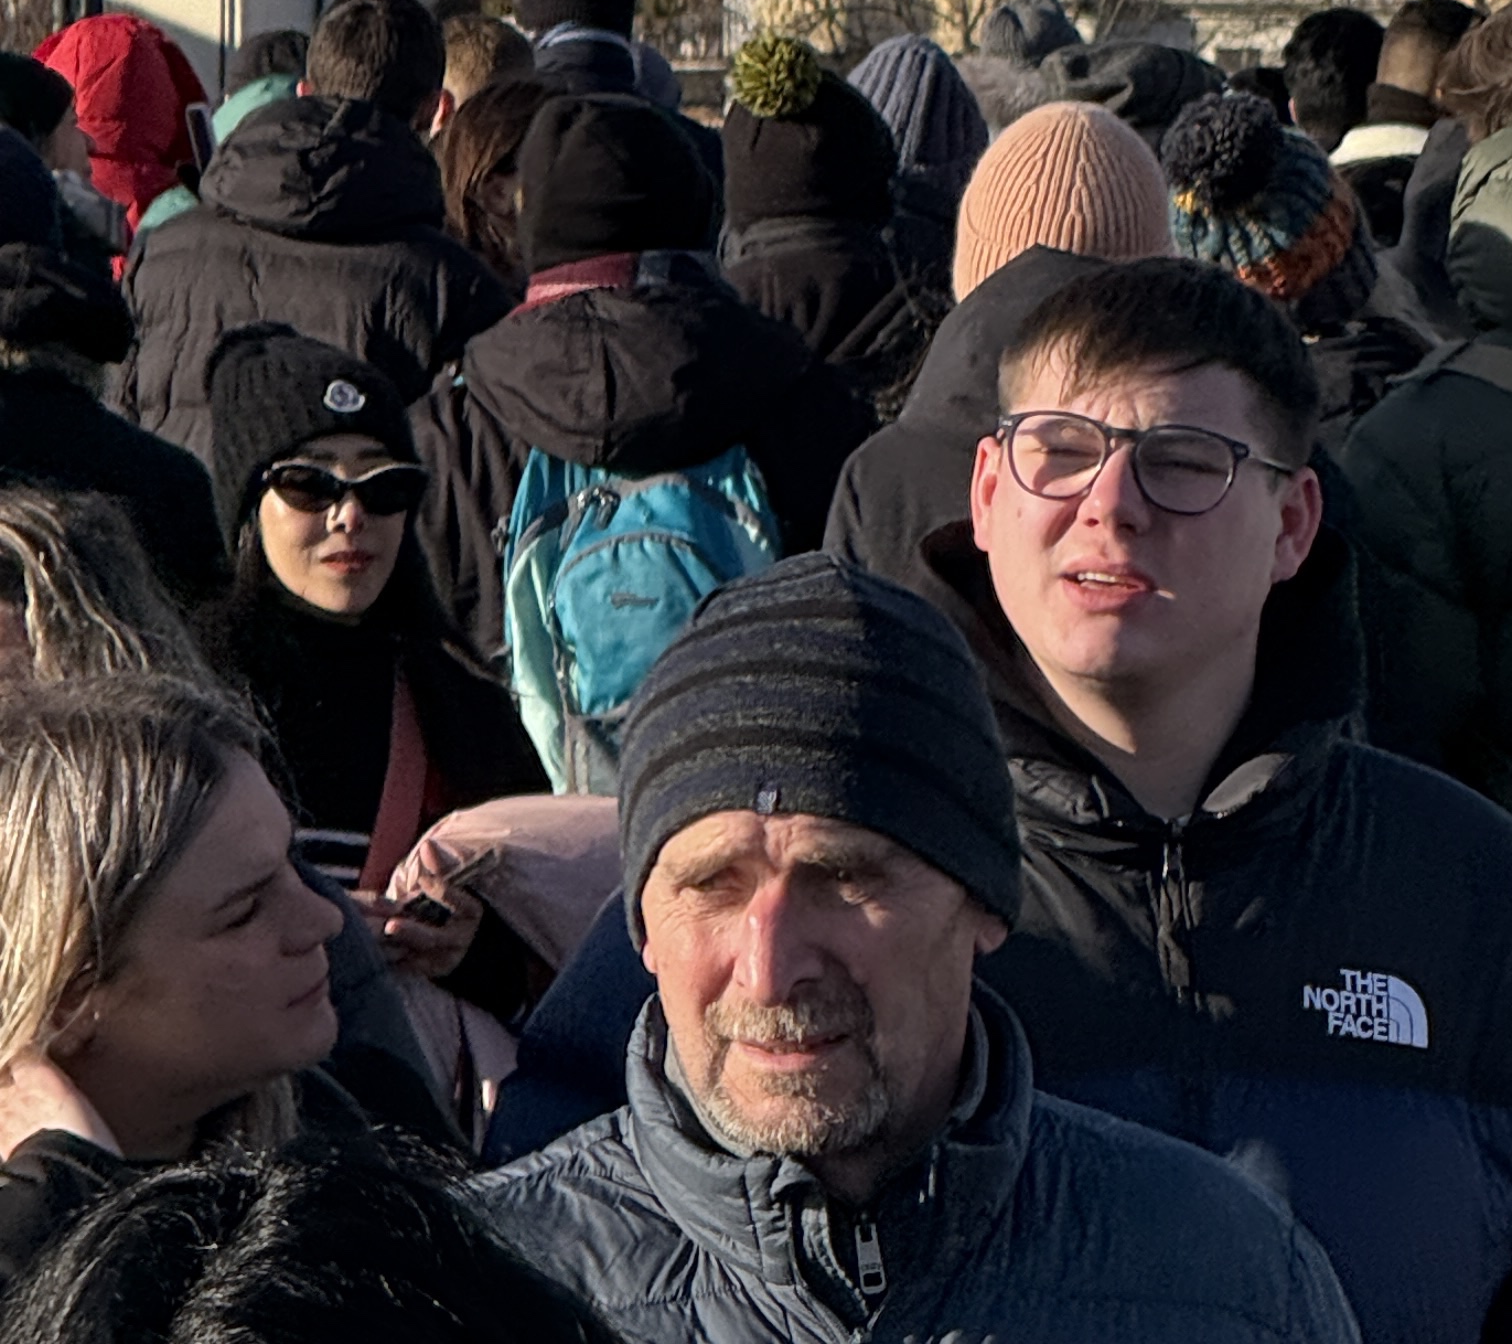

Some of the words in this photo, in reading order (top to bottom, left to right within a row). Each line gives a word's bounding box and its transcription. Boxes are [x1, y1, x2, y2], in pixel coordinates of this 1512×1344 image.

[1340, 968, 1388, 996] THE
[1303, 985, 1388, 1018] NORTH
[1328, 1012, 1388, 1042] FACE
